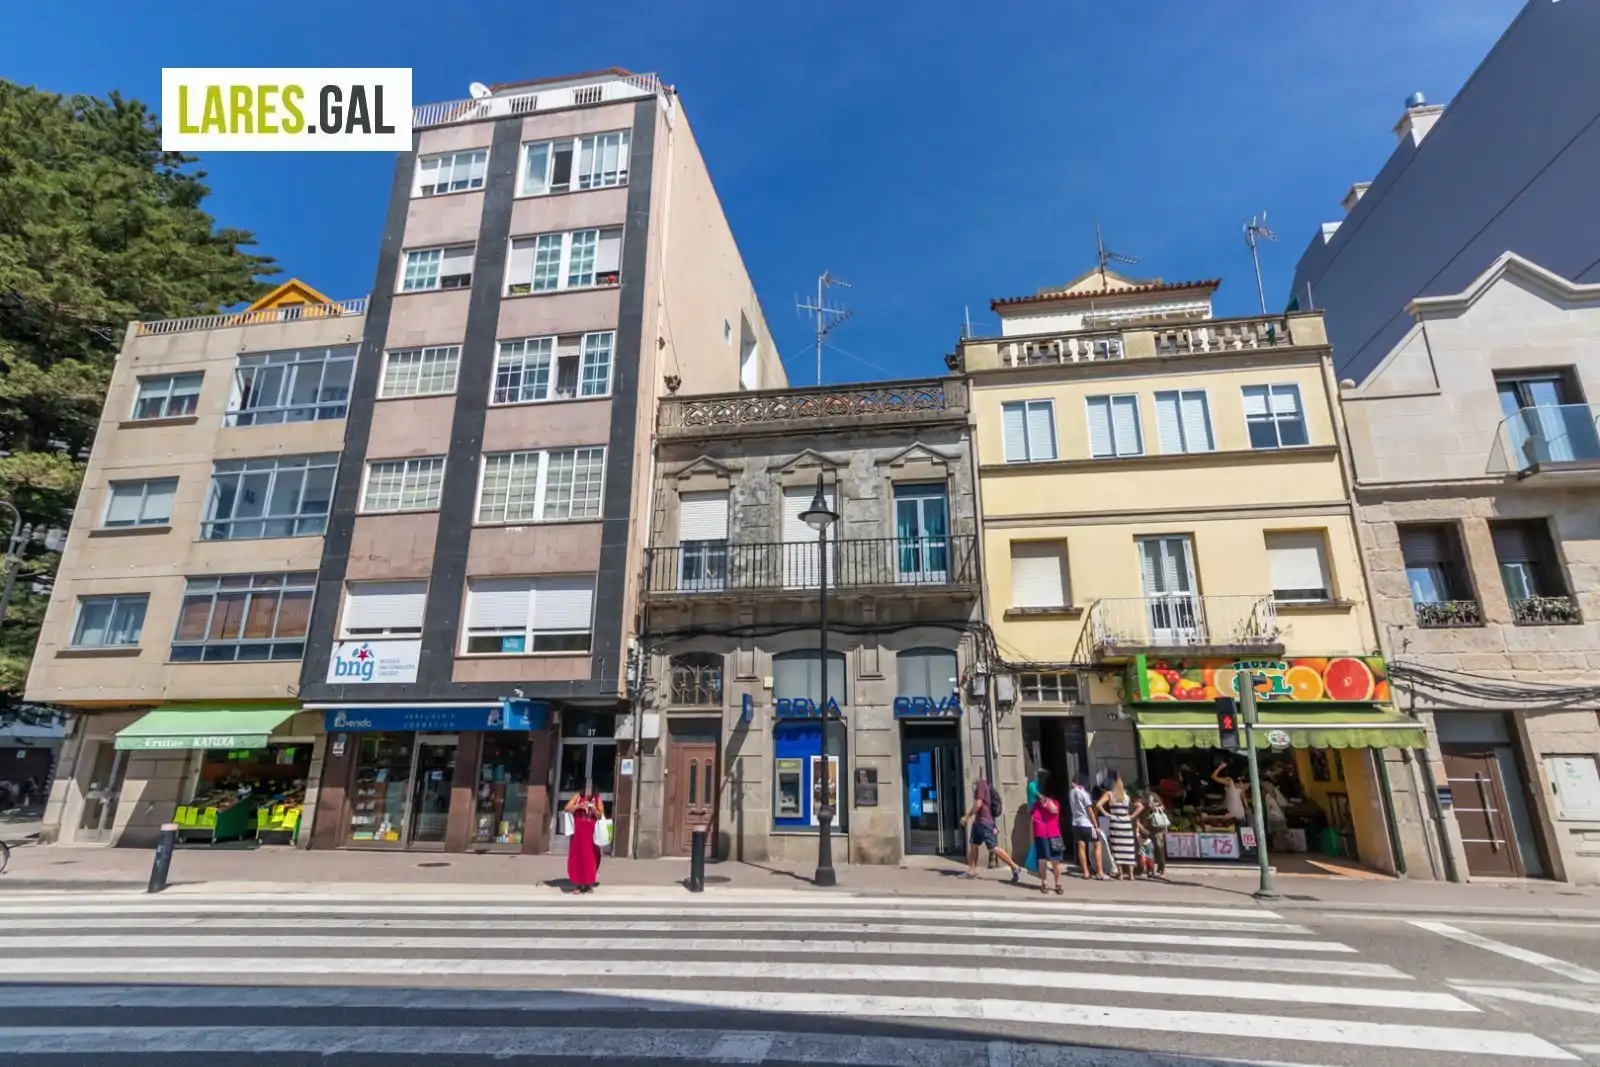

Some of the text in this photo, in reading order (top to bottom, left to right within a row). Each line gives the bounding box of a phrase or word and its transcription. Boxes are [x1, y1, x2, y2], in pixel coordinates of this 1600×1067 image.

[335, 656, 375, 681] bng
[1232, 661, 1288, 671] FRUTAS
[775, 696, 842, 719] BBVA
[894, 692, 963, 718] BBVA
